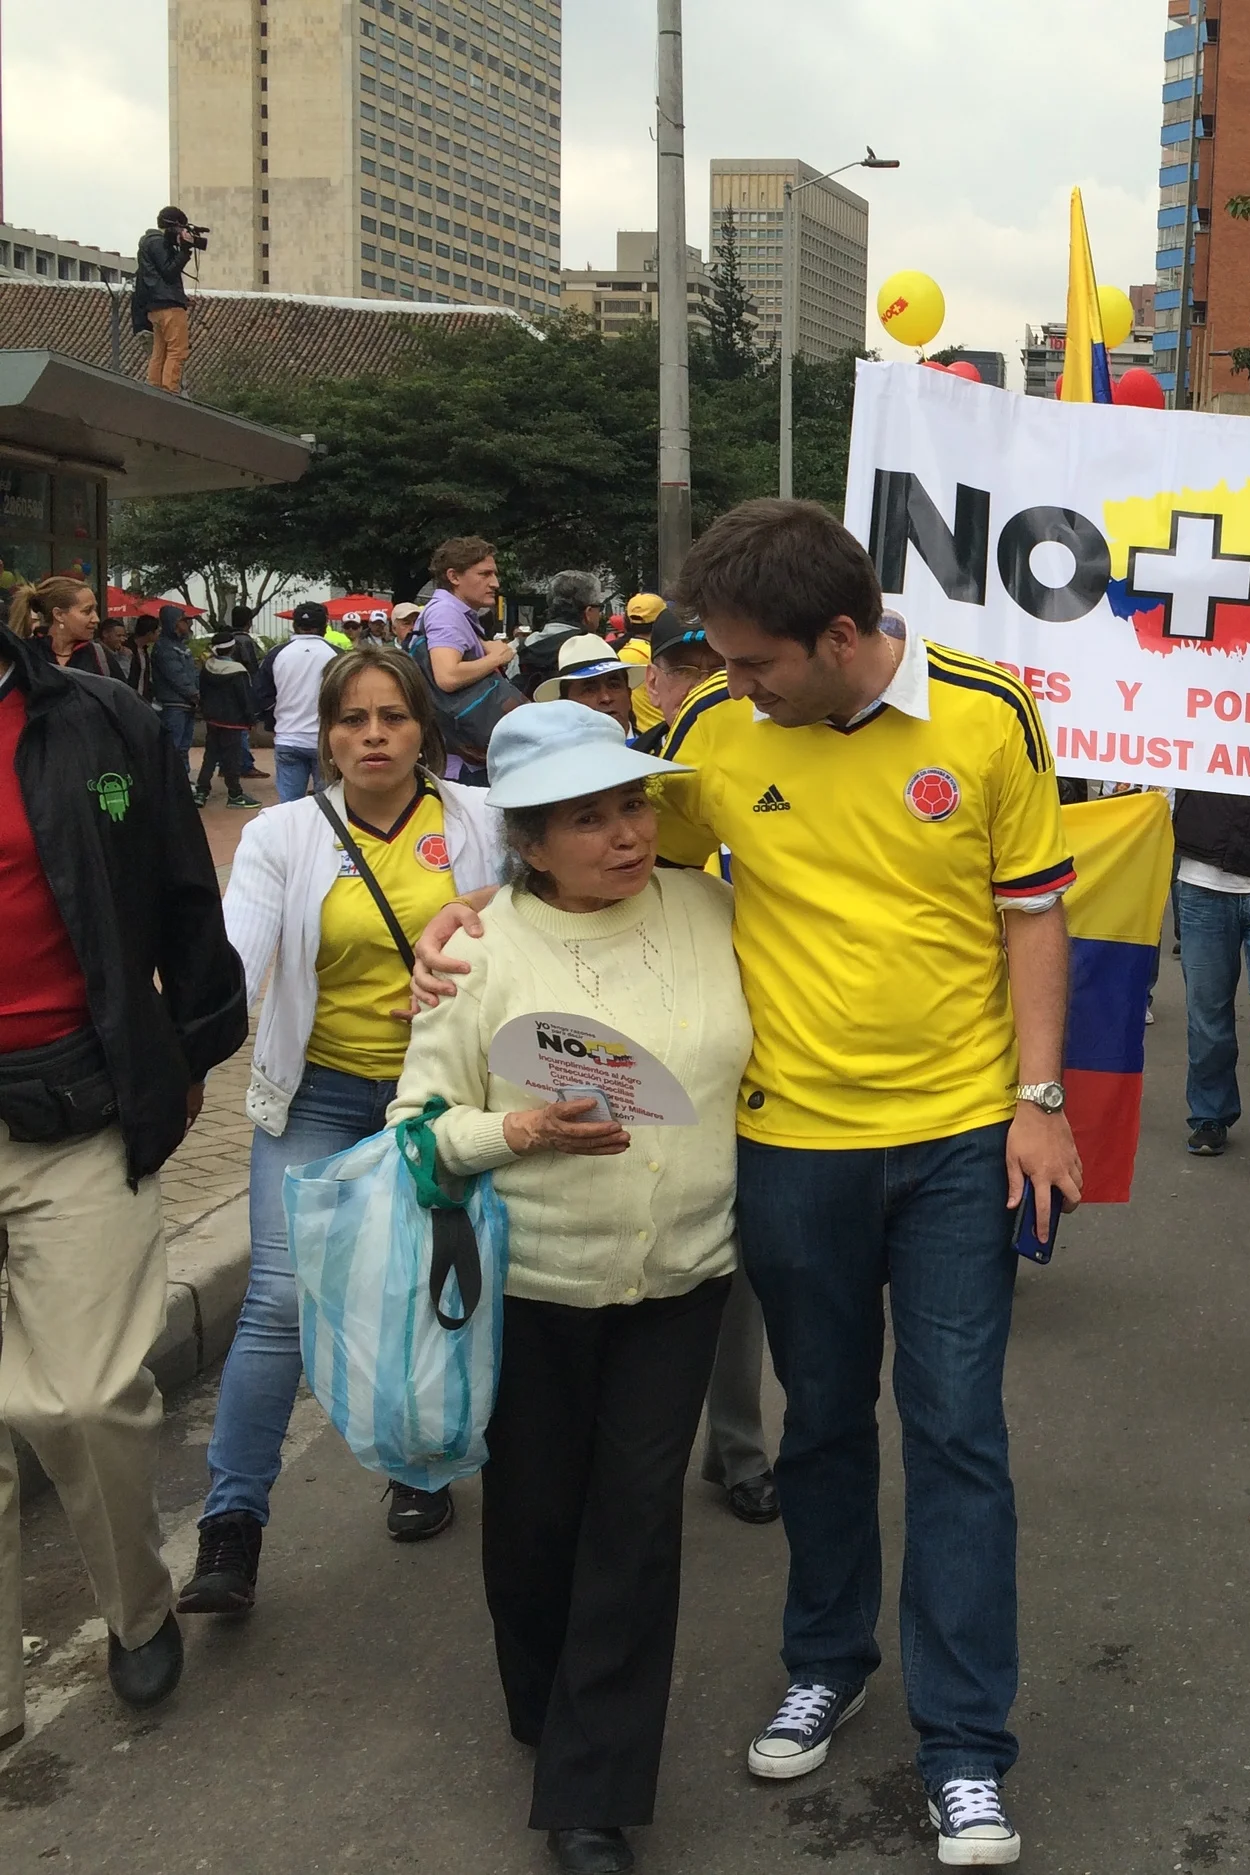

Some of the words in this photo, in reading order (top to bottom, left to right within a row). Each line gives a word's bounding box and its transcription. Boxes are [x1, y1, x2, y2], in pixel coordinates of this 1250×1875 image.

[1115, 680, 1142, 712] Y
[1056, 726, 1194, 771] INJUST
[753, 801, 791, 812] adidas
[538, 1053, 610, 1077] Incumplimientos
[620, 1074, 642, 1086] Agro
[548, 1063, 602, 1082] Persecución
[550, 1070, 584, 1085] Curules
[628, 1105, 664, 1120] Militares
